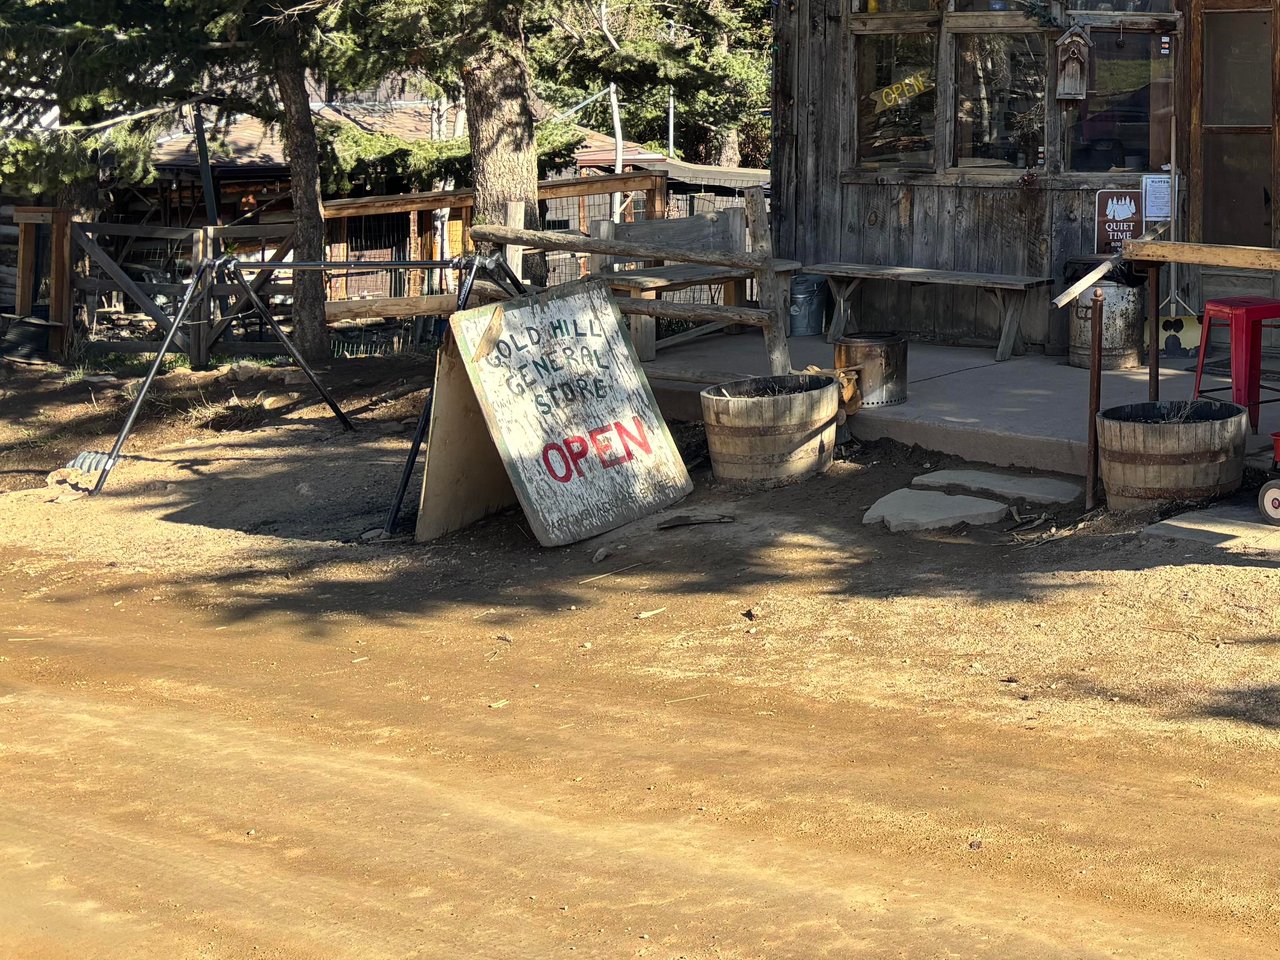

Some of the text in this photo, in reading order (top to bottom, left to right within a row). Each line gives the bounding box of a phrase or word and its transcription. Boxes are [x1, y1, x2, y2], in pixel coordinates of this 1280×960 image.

[882, 73, 925, 106] OPEN
[1105, 222, 1135, 232] QUIET
[1107, 231, 1132, 240] TIME
[485, 319, 602, 368] GOLD HILL
[506, 346, 610, 397] GENERAL
[535, 378, 608, 416] STORE
[542, 415, 653, 484] OPEN
